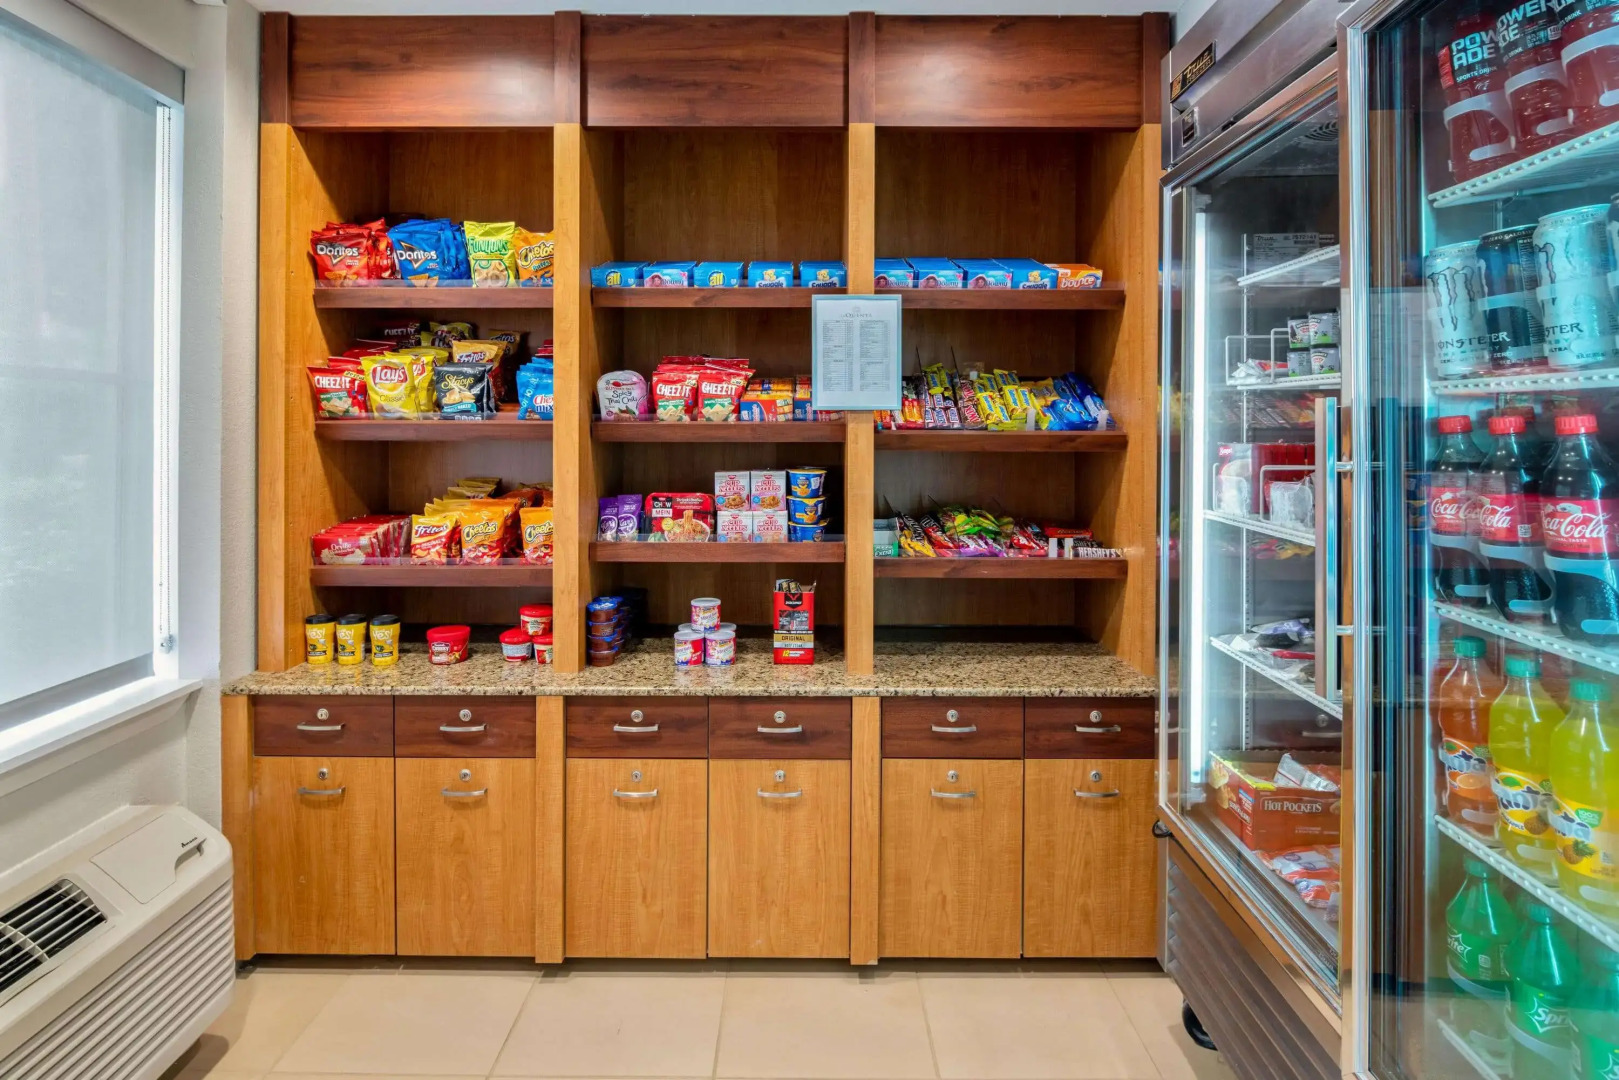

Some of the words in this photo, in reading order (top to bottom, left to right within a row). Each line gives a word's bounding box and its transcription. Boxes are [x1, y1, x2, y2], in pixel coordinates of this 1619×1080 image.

[1453, 43, 1496, 70] ADE
[1456, 70, 1478, 83] SPORTS
[316, 244, 359, 256] Doritos
[397, 249, 437, 261] Doritos
[606, 272, 621, 286] all
[709, 272, 723, 286] all
[1061, 276, 1094, 288] bounce
[372, 365, 405, 384] Lay's
[605, 397, 620, 405] Thai
[612, 390, 632, 399] Spicy
[414, 521, 449, 537] Fritos
[463, 521, 498, 543] Cheetos
[1264, 800, 1283, 811] HOT
[1283, 802, 1322, 813] POCKETS
